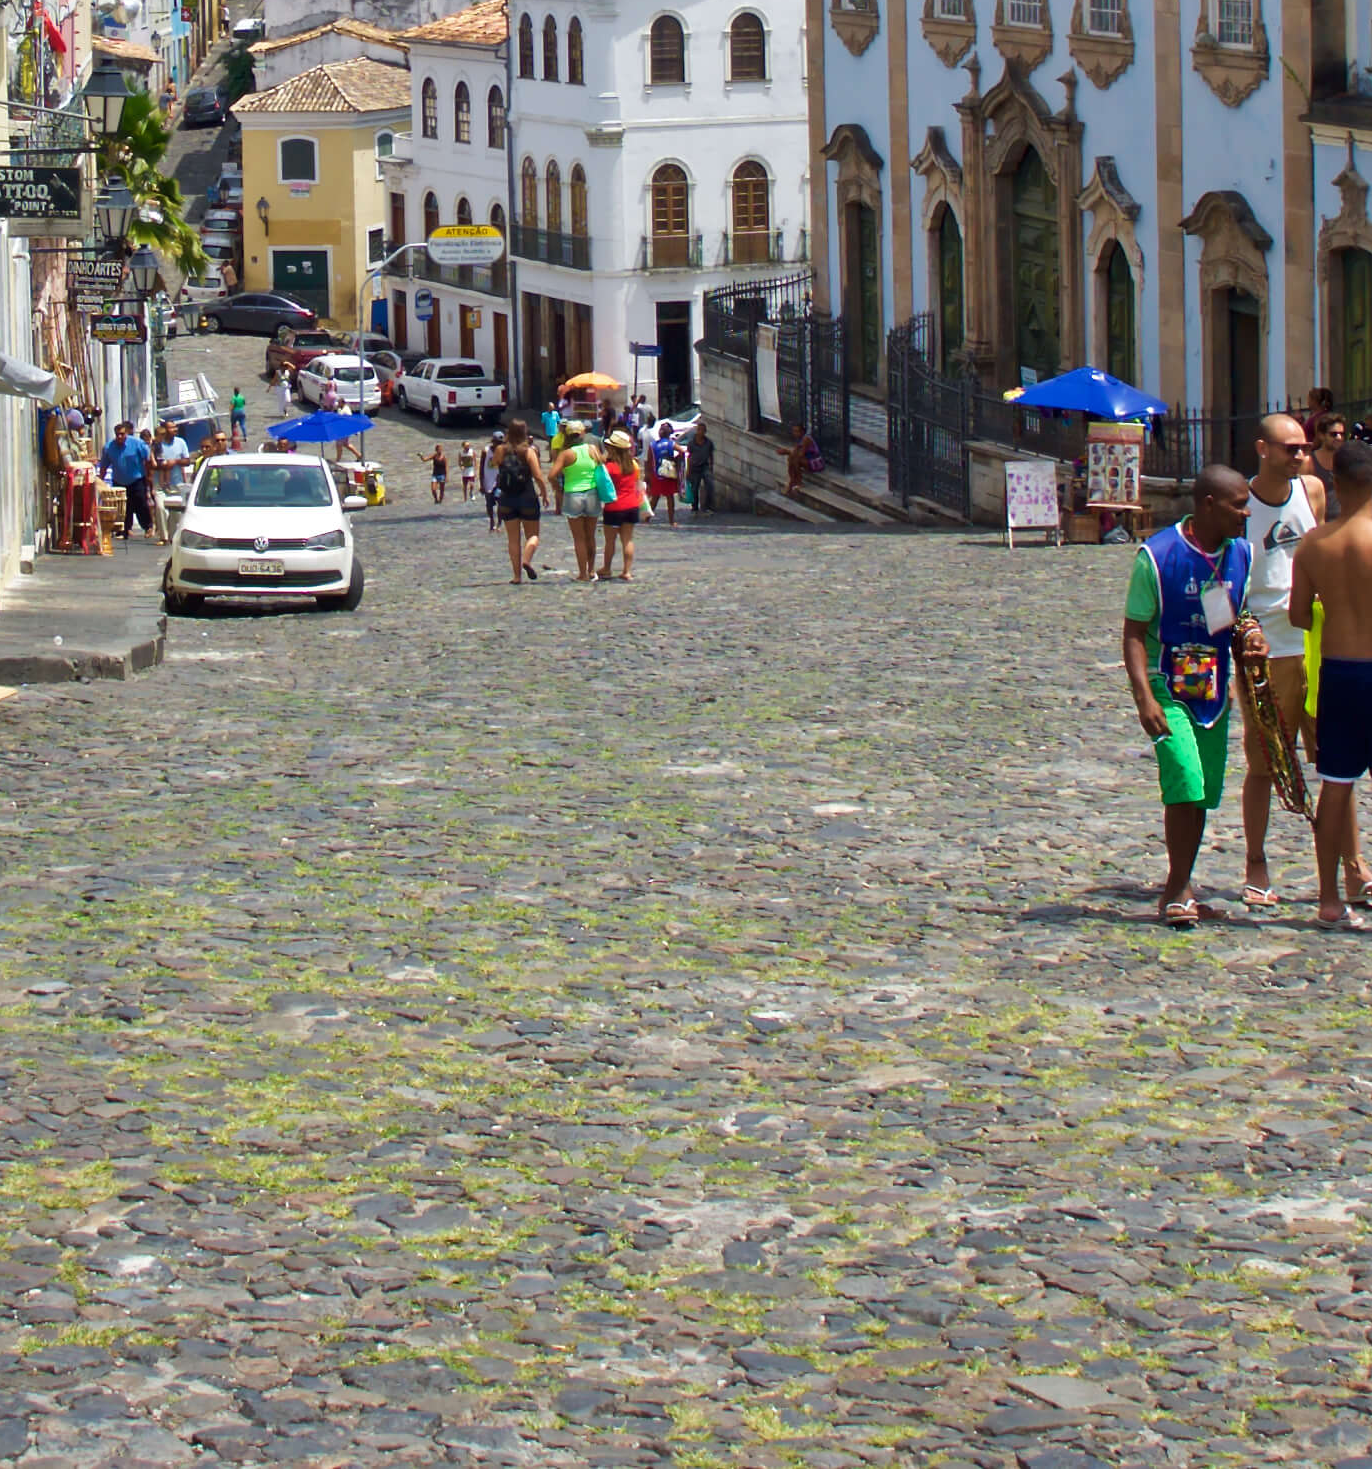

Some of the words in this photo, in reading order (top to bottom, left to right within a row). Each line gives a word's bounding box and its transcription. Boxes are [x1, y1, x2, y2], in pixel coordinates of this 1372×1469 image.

[14, 201, 47, 211] POINT
[446, 227, 488, 236] ATENÇÃO
[68, 261, 94, 276] DINHO
[94, 262, 122, 276] ARTES
